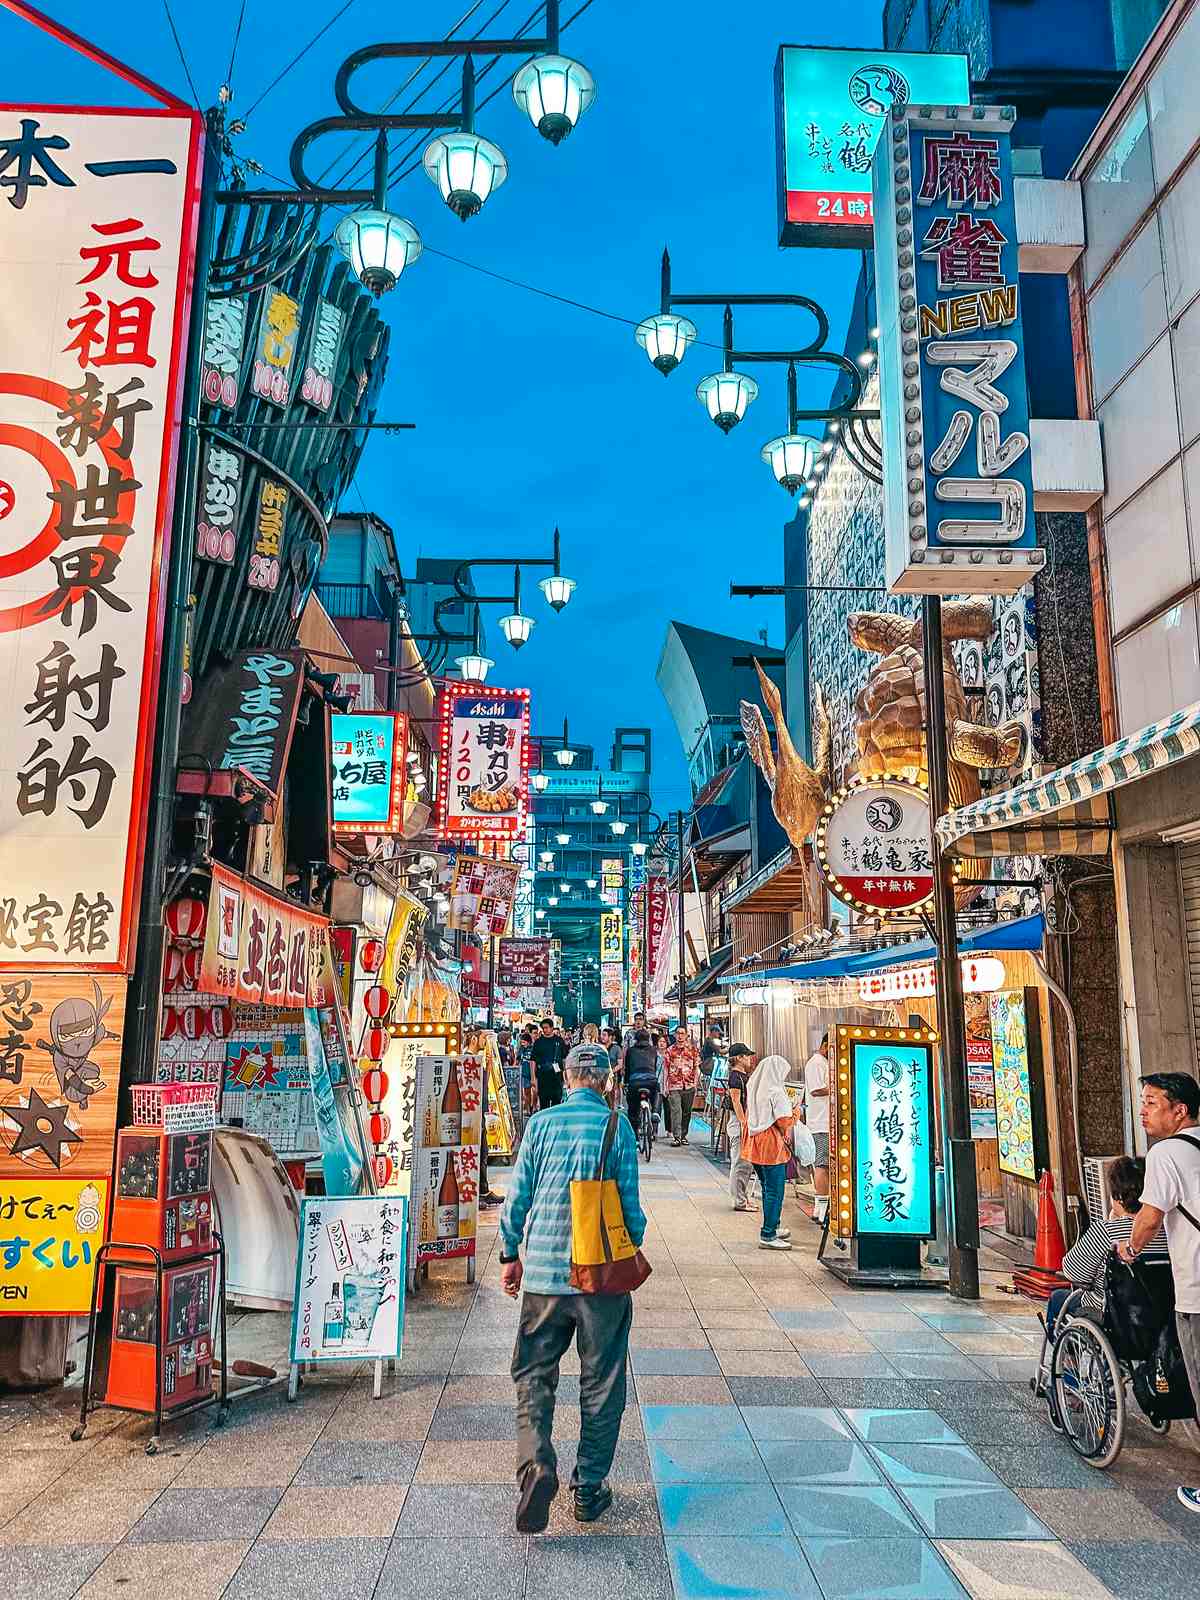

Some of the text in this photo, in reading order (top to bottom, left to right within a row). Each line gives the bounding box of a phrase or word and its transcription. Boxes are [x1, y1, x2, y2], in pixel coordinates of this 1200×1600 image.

[839, 122, 873, 138] 名代
[816, 198, 873, 218] 24時
[917, 131, 1008, 288] 麻雀
[919, 284, 1018, 338] NEW
[926, 339, 1030, 543] マルコ
[197, 521, 236, 562] 100
[248, 554, 280, 591] 250
[470, 702, 505, 716] Asahi
[477, 720, 508, 792] 串カツ
[332, 786, 350, 801] 店
[861, 846, 934, 871] 鶴亀家
[862, 879, 917, 892] 年中無休
[603, 915, 621, 950] 射的
[501, 953, 547, 967] ビリーズ
[433, 1060, 444, 1097] 一番搾り
[460, 1056, 481, 1113] 激安
[874, 1088, 902, 1103] 名代
[907, 1059, 921, 1099] 串かつ
[430, 1151, 440, 1190] 一番搾り
[458, 1146, 479, 1203] 激安
[873, 1104, 910, 1222] 鶴亀家
[304, 1211, 323, 1289] 翠ジンソーダ
[331, 1224, 348, 1266] ジンソーダ
[300, 1300, 312, 1349] 300円
